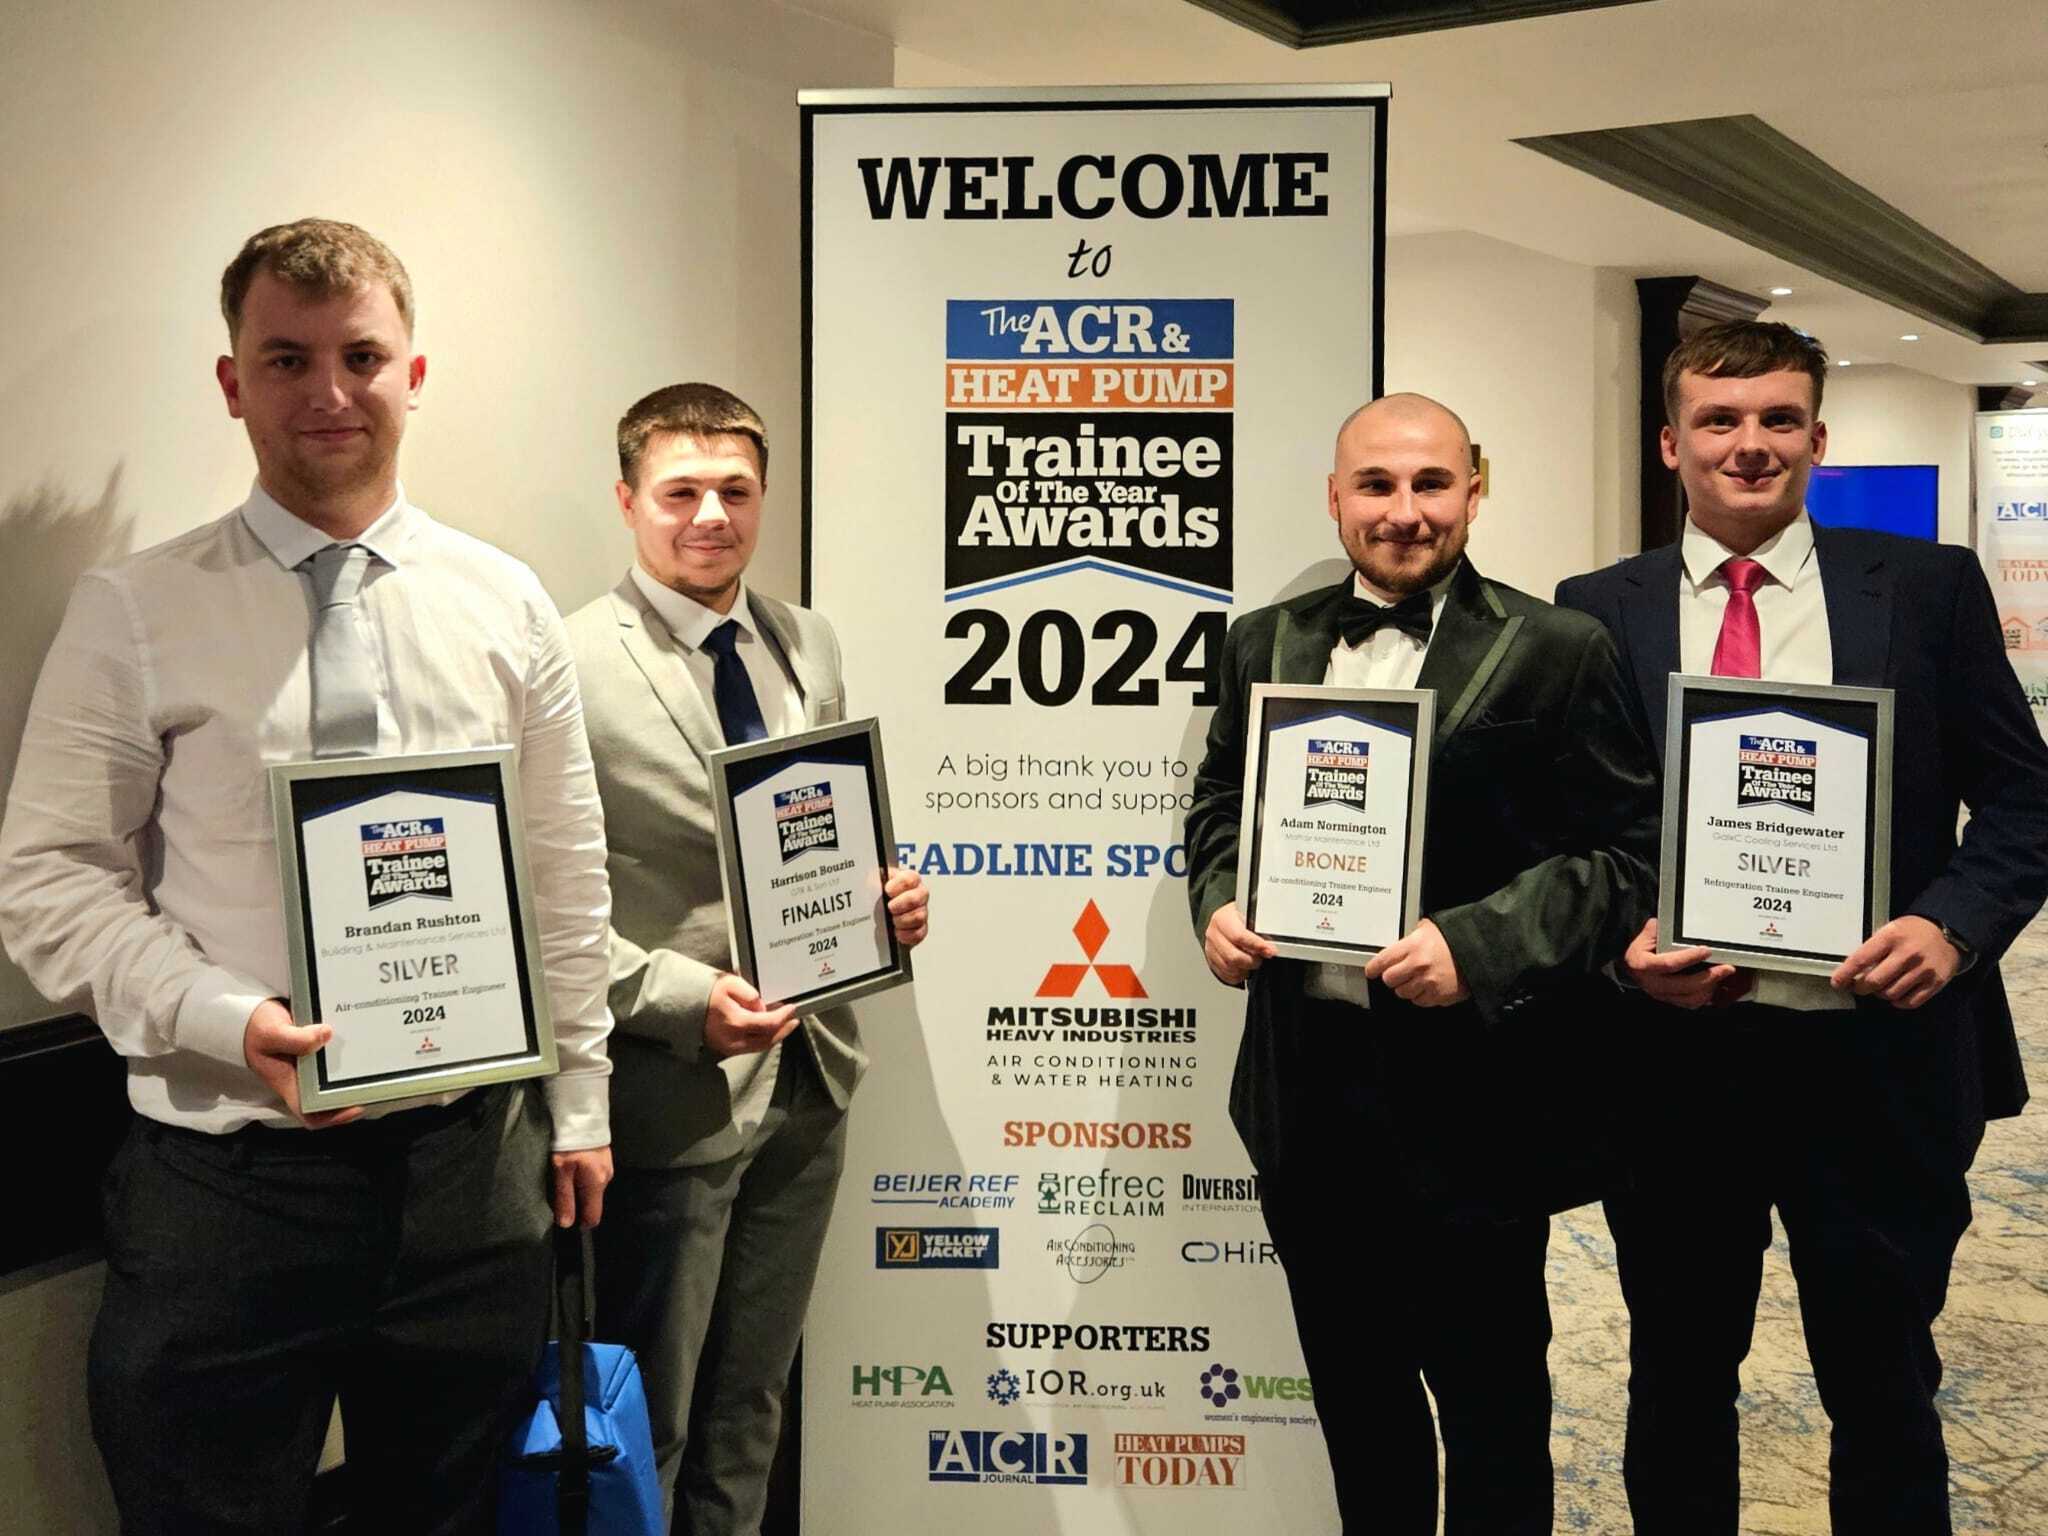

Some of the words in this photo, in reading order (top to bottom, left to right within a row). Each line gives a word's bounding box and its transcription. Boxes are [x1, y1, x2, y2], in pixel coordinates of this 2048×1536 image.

[857, 152, 1329, 220] WELCOME
[1067, 238, 1113, 279] to
[980, 306, 1032, 338] The
[1019, 305, 1158, 355] ACR
[1161, 323, 1191, 353] &
[951, 368, 1080, 404] HEAT
[1092, 368, 1228, 403] PUMP
[957, 423, 1221, 478] Trainee
[996, 481, 1031, 504] Of
[1034, 481, 1089, 503] The
[1096, 481, 1158, 504] Year
[957, 494, 1220, 548] Awards
[944, 609, 1229, 707] 2024
[1323, 741, 1353, 754] ACR
[1759, 738, 1797, 753] ACR
[937, 754, 956, 776] A
[966, 753, 1008, 782] big
[1018, 754, 1095, 777] thank
[1102, 760, 1151, 782] you
[1161, 755, 1188, 778] to
[1307, 756, 1337, 765] HEAT
[1338, 757, 1368, 767] PUMP
[1740, 751, 1775, 763] HEAT
[1778, 755, 1815, 767] PUMP
[1308, 768, 1365, 784] Trainee
[1741, 765, 1813, 785] Trainee
[788, 786, 816, 804] ACR
[925, 791, 1040, 813] sponsors
[1048, 787, 1102, 811] and
[1307, 786, 1364, 801] Awards
[1741, 783, 1812, 802] Awards
[383, 820, 423, 838] ACR
[780, 812, 833, 836] Trainee
[1281, 818, 1314, 830] Adam
[1317, 820, 1387, 836] Normington
[1707, 816, 1751, 831] James
[1756, 821, 1845, 840] Bridgewater
[364, 839, 402, 854] HEAT
[405, 837, 446, 851] PUMP
[783, 828, 835, 852] Awards
[367, 855, 446, 875] Trainee
[1295, 851, 1367, 873] BRONZE
[1737, 852, 1811, 878] SILVER
[370, 872, 448, 895] Awards
[771, 869, 817, 889] Harrison
[820, 859, 855, 875] Bouzin
[1312, 892, 1343, 907] 2024
[1704, 877, 1763, 892] Refrigeration
[1766, 884, 1800, 896] Trainee
[1802, 888, 1844, 901] Engineer
[782, 890, 853, 926] FINALIST
[1753, 896, 1792, 913] 2024
[345, 919, 412, 938] Brandan
[416, 912, 481, 929] Rushton
[808, 936, 838, 956] 2024
[379, 953, 460, 984] SILVER
[402, 1005, 446, 1025] 2024
[987, 1007, 1197, 1028] MITSUBISHI
[986, 1029, 1055, 1041] HEAVY
[1063, 1030, 1197, 1044] INDUSTRIES
[987, 1055, 1022, 1067] AIR
[1034, 1055, 1198, 1069] CONDITIONING
[991, 1073, 1002, 1086] &
[1014, 1073, 1088, 1087] WATER
[1099, 1075, 1193, 1088] HEATING
[1003, 1121, 1192, 1149] SPONSORS
[874, 1174, 962, 1192] BEIJER
[968, 1174, 1020, 1192] REF
[1064, 1168, 1165, 1199] refrec
[938, 1196, 1016, 1209] ACADEMY
[1064, 1200, 1164, 1217] RECLAIM
[922, 1235, 990, 1247] YELLOW
[922, 1247, 984, 1259] JACKET
[986, 1322, 1211, 1353] SUPPORTERS
[1026, 1369, 1166, 1400] IOR.org.uk
[935, 1431, 1077, 1474] ACR
[1117, 1435, 1173, 1452] HEAT
[1175, 1435, 1241, 1453] PUMPS
[983, 1474, 1034, 1485] JOURNAL
[1117, 1456, 1240, 1487] TODAY
